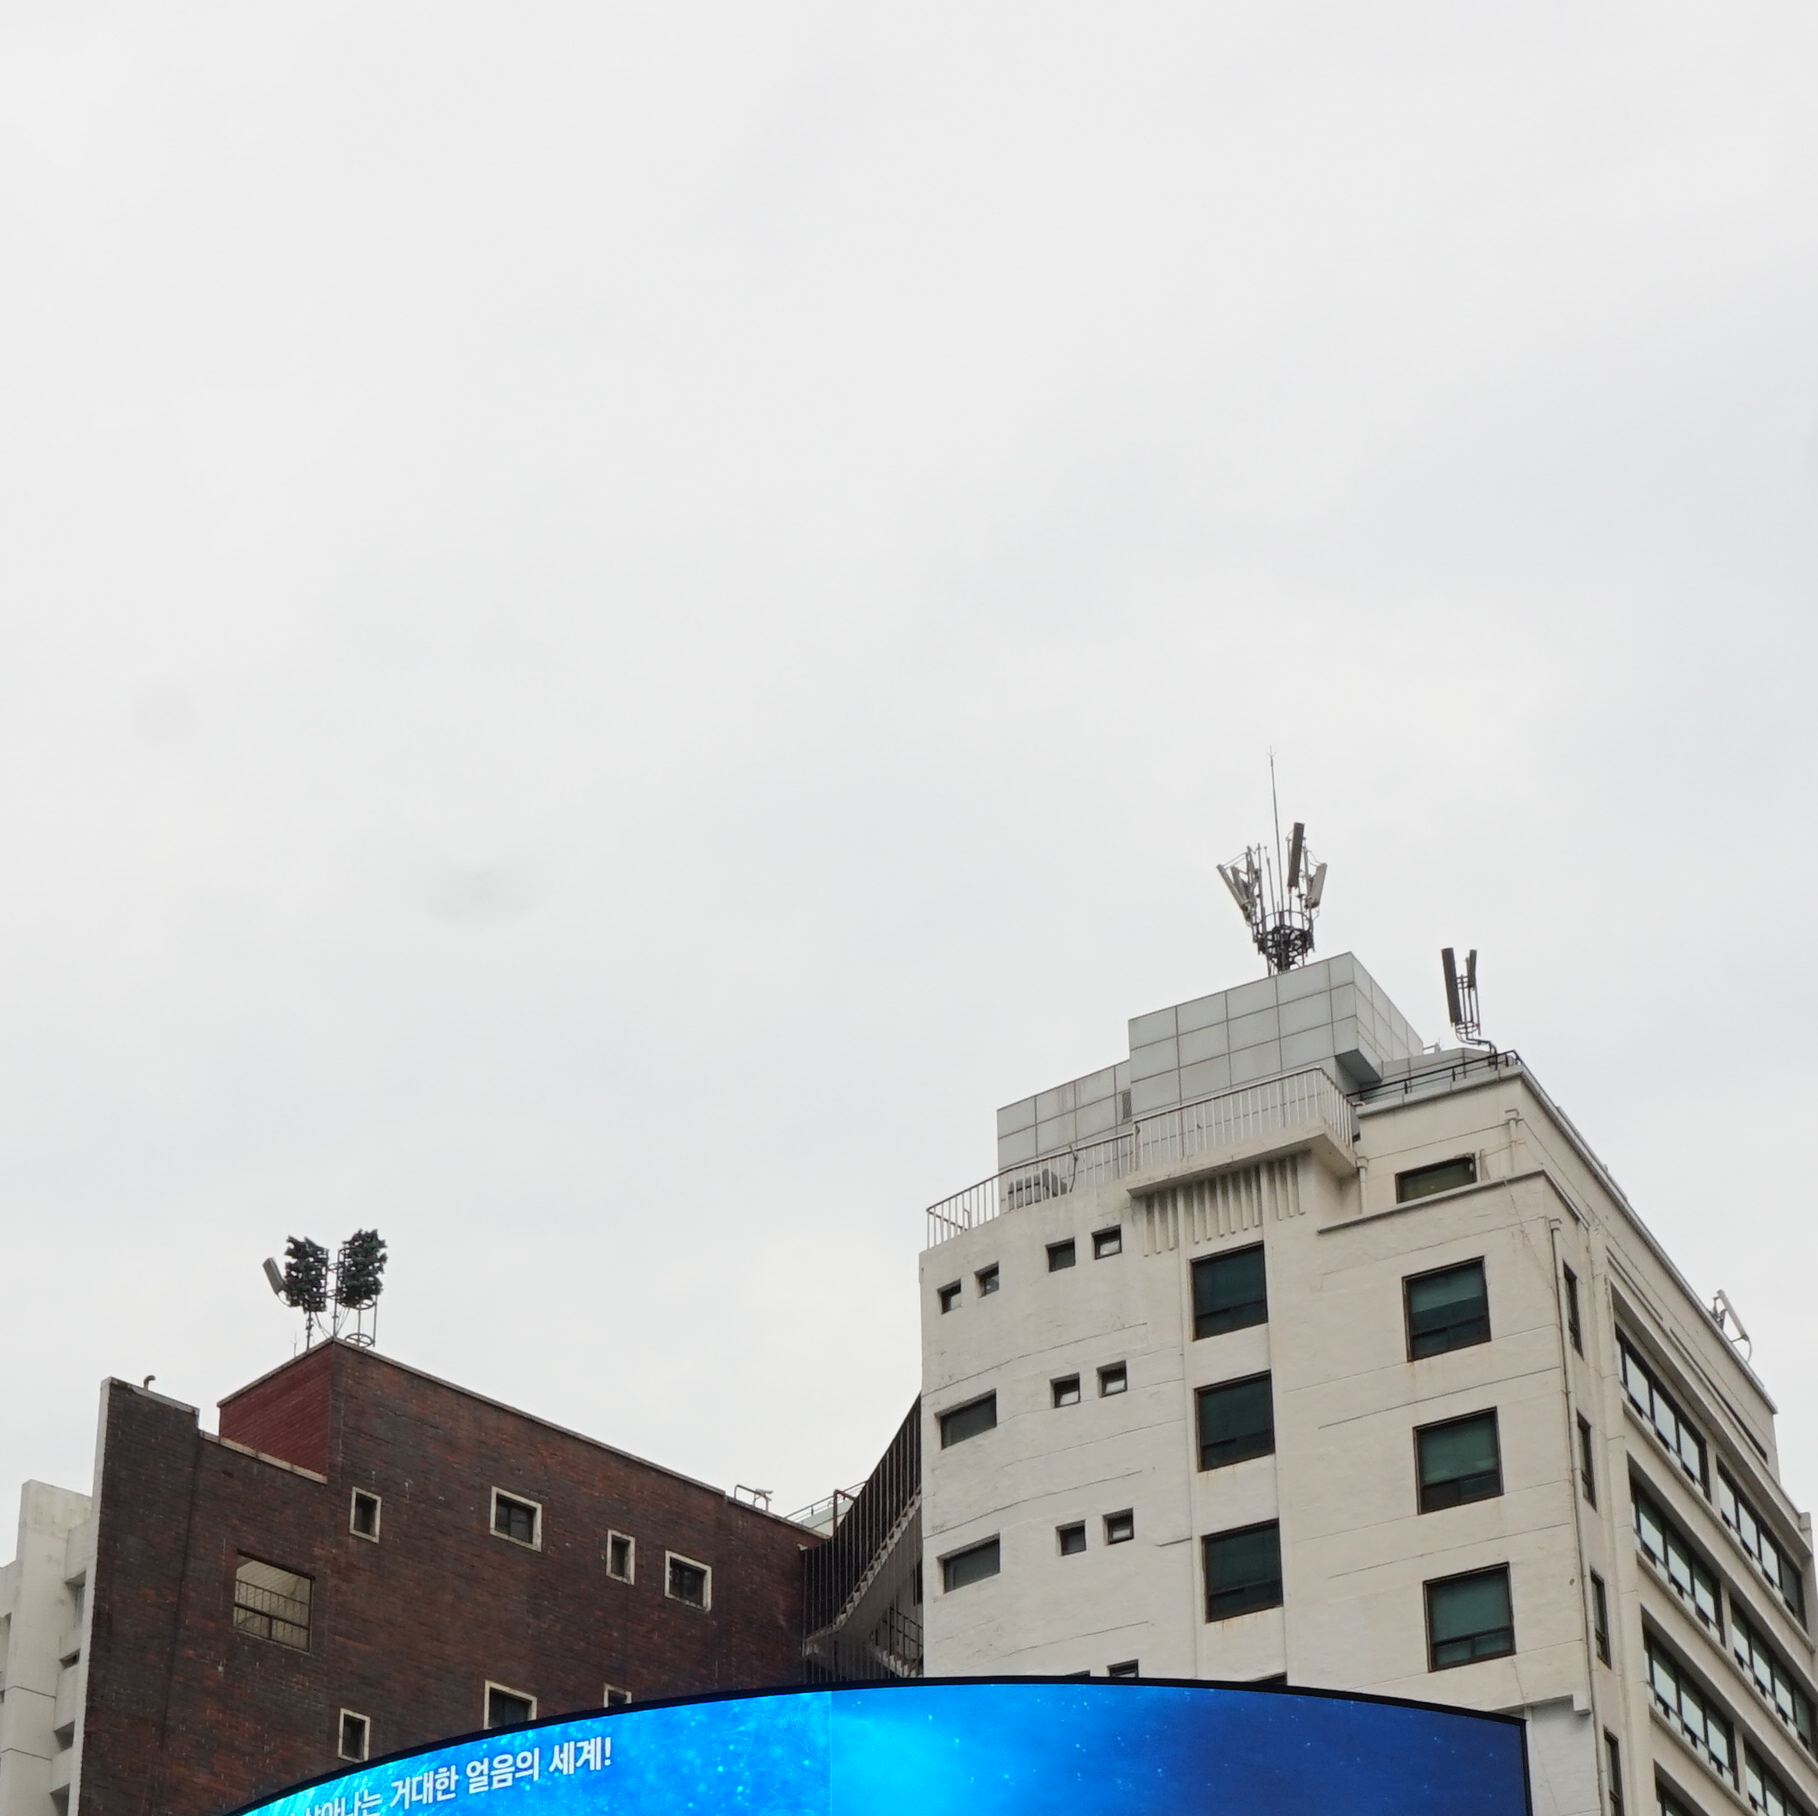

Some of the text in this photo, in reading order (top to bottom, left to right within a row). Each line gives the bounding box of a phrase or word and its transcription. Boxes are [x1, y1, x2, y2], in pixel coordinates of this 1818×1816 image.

[391, 1766, 458, 1811] 거대한
[465, 1750, 540, 1791] 얼음의
[549, 1736, 612, 1777] 세계!
